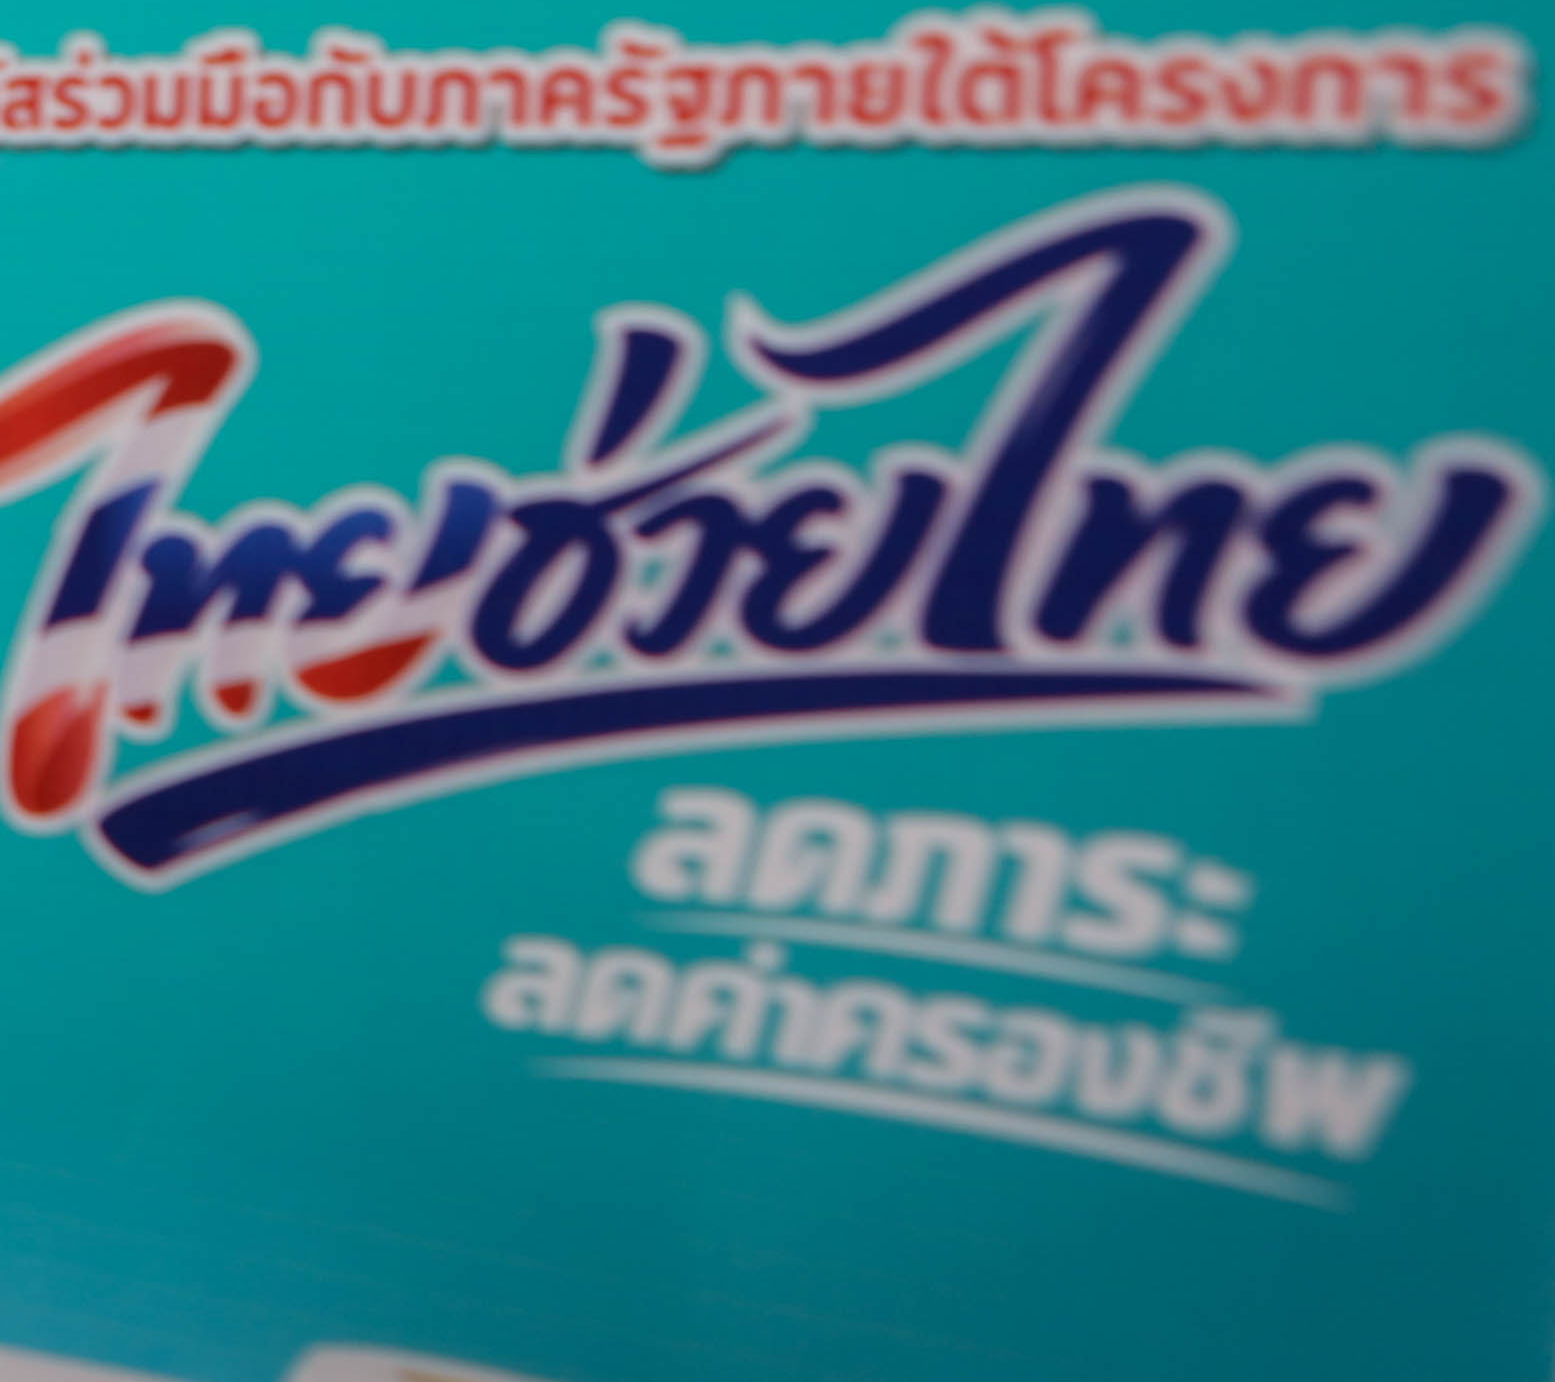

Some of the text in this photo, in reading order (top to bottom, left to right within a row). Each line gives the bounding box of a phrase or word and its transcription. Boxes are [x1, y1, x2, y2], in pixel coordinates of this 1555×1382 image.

[630, 784, 1254, 963] ลดภาระ
[482, 933, 1412, 1160] ลดค่าครองชีพ
